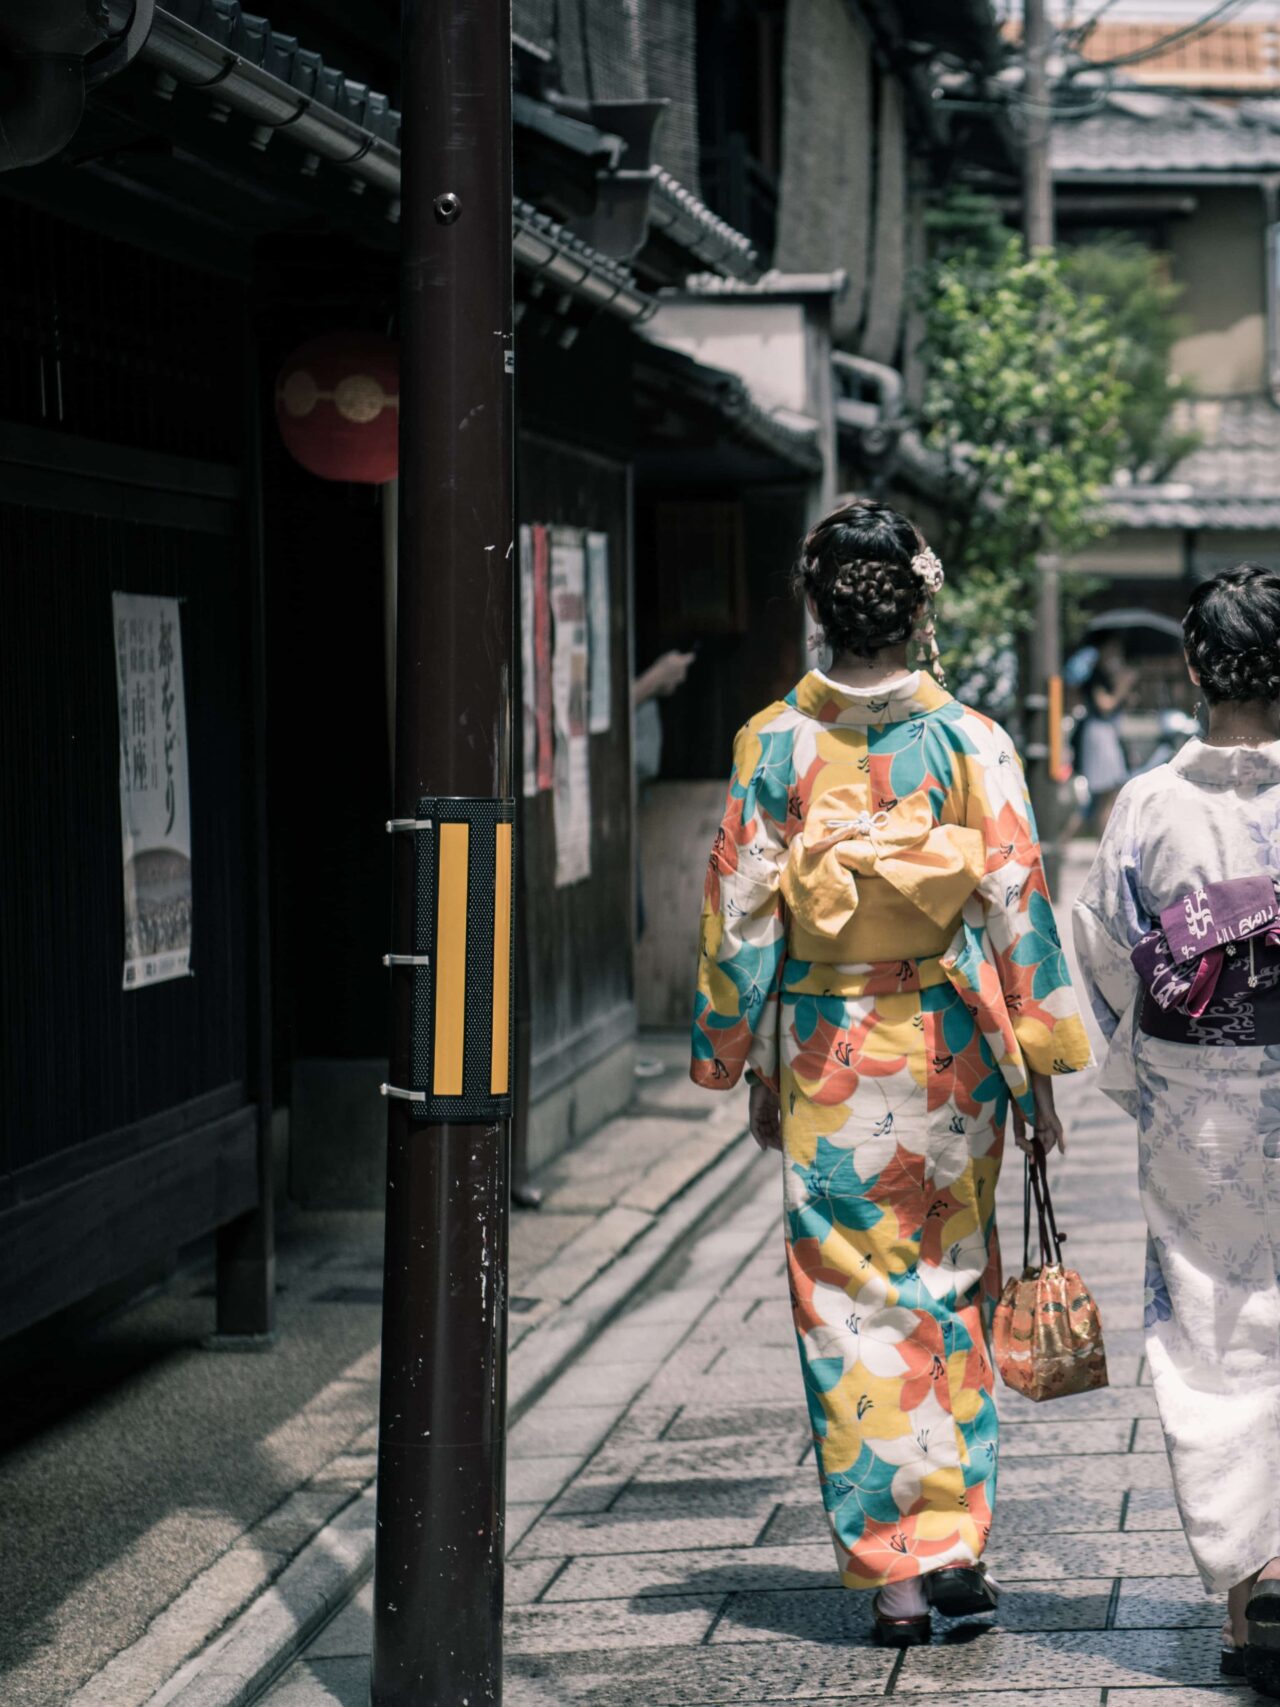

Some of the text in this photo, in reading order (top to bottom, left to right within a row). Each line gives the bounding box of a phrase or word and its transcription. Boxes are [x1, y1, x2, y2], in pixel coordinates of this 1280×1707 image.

[131, 681, 148, 791] 南座
[158, 609, 175, 836] 都をどり
